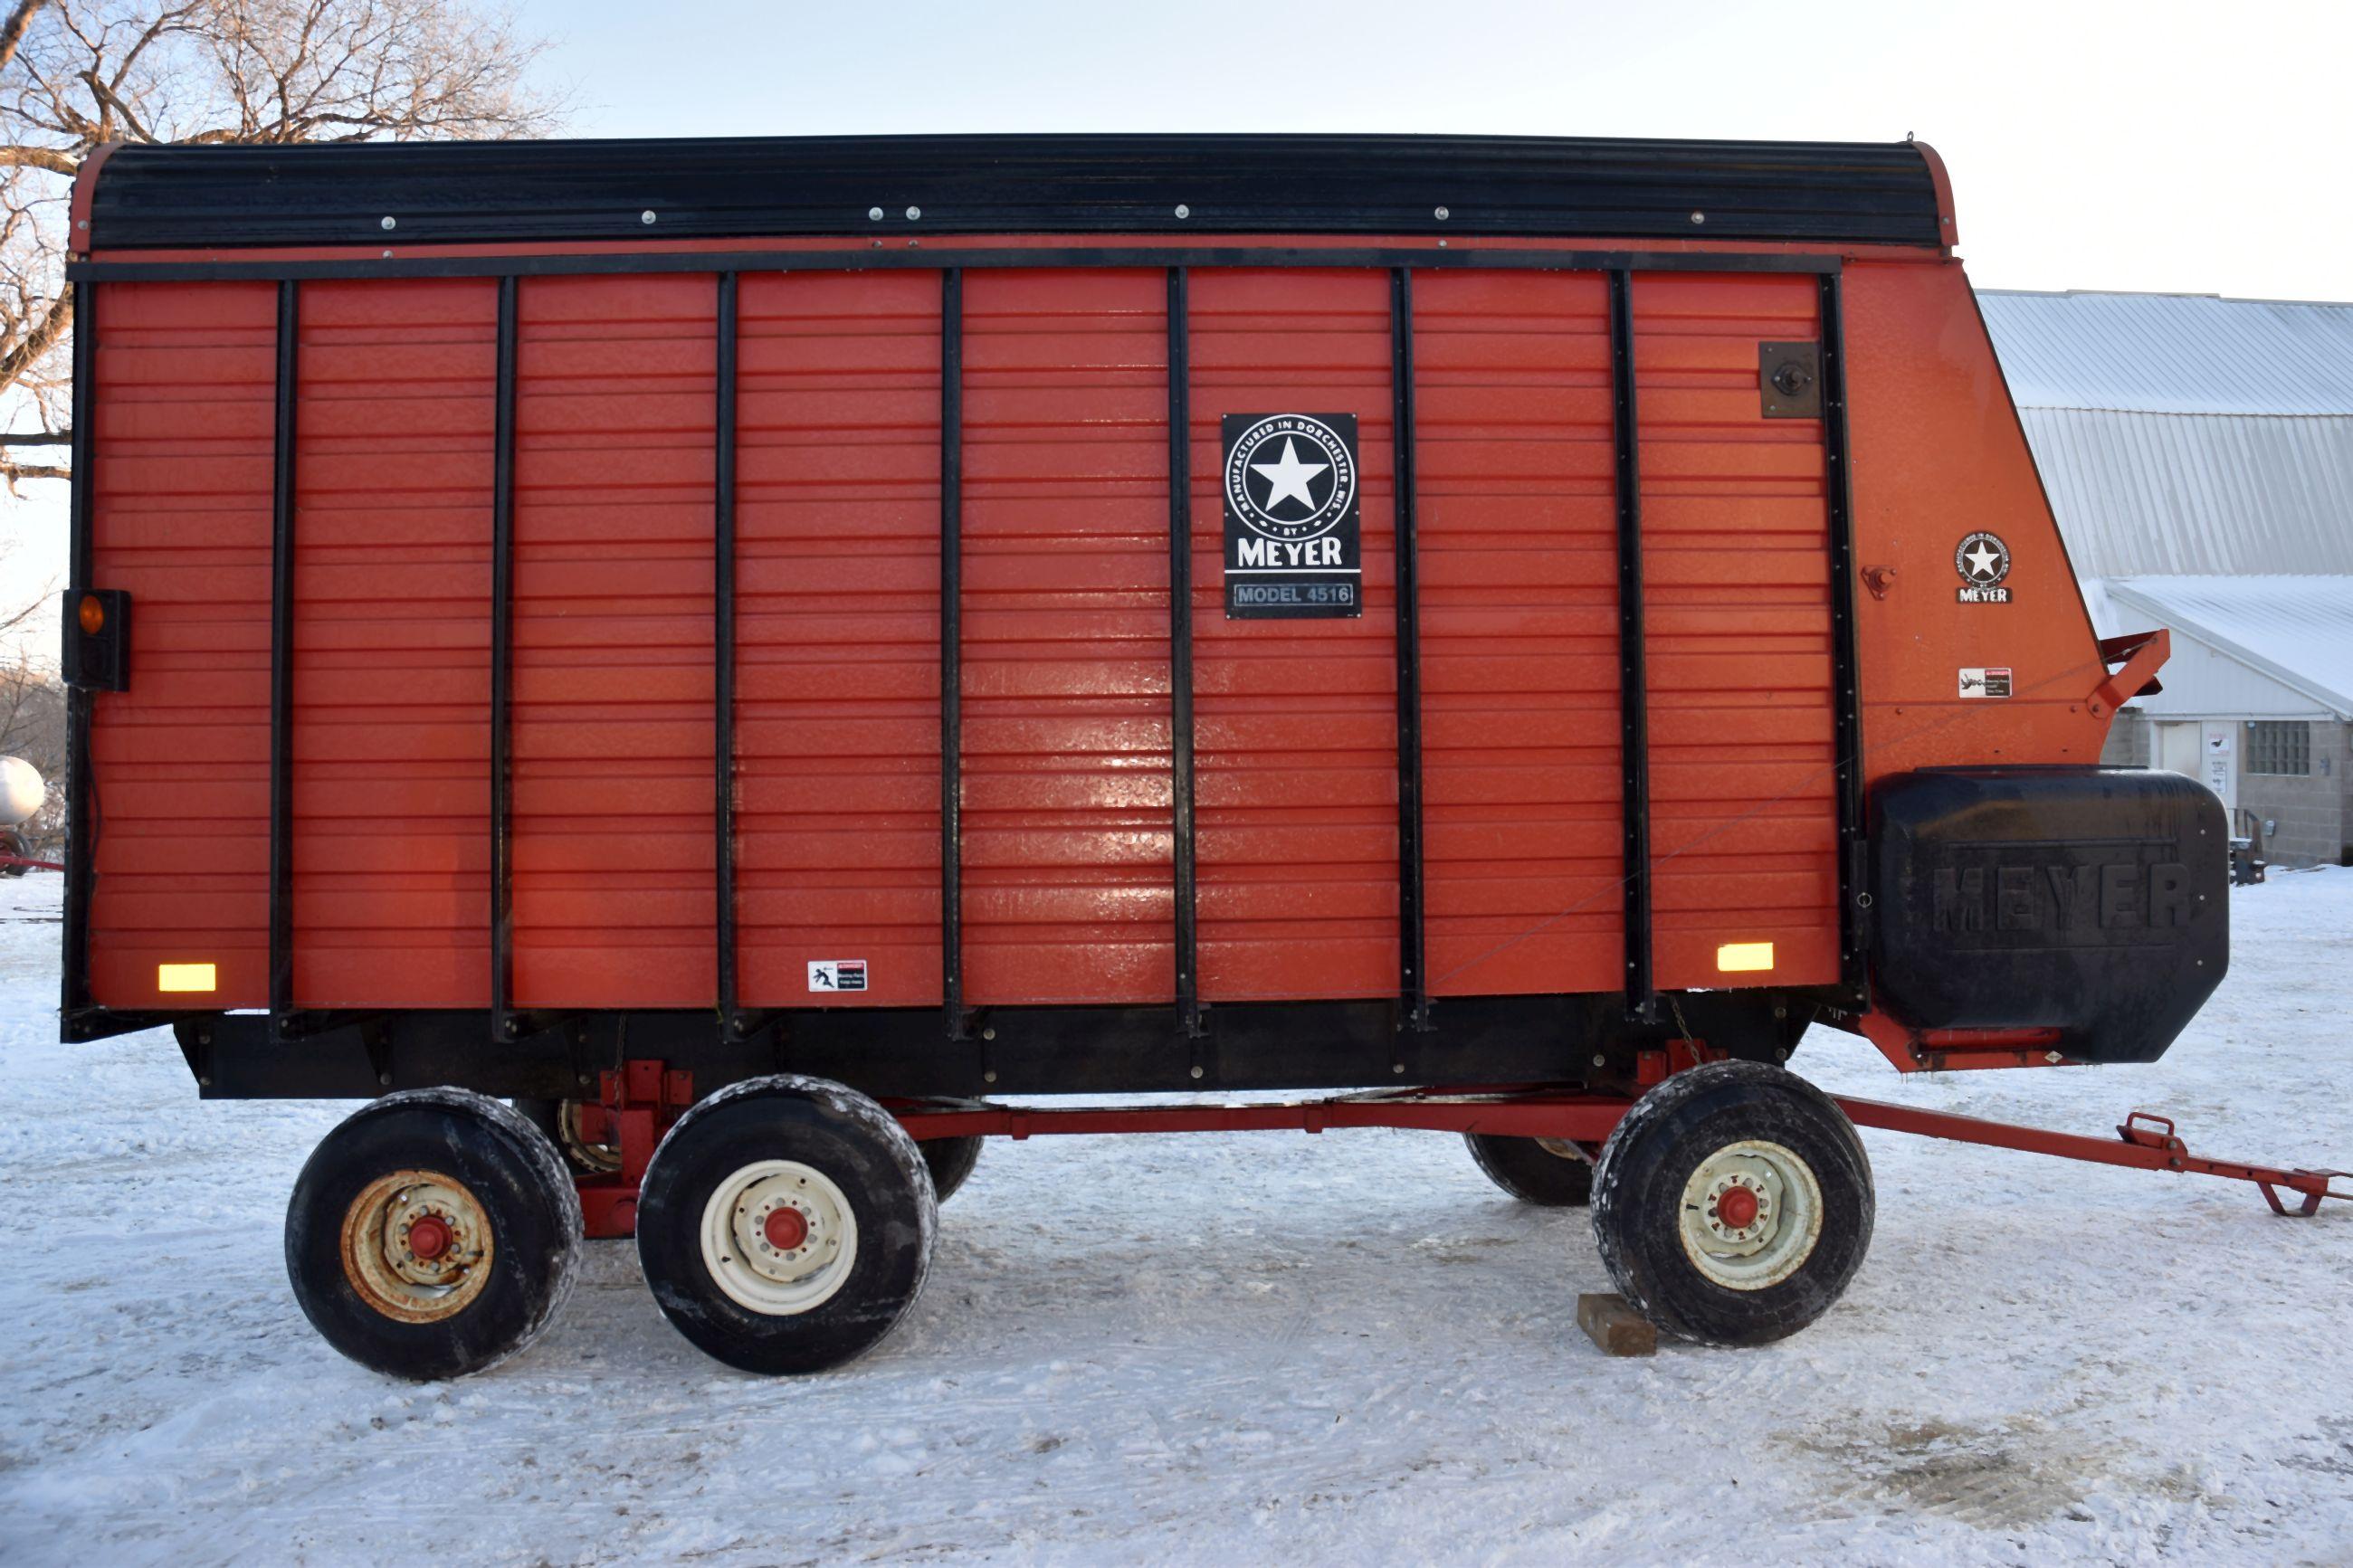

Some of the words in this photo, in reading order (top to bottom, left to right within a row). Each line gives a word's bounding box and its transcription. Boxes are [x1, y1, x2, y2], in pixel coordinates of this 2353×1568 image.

[1233, 423, 1274, 512] MANUFACTURED
[1278, 420, 1292, 430] IN
[1283, 527, 1298, 536] BY
[1237, 537, 1343, 567] MEYER
[1238, 587, 1301, 603] MODEL
[1307, 587, 1349, 602] 4516
[1959, 588, 2007, 603] MEYER
[1932, 862, 2191, 932] MEYER
